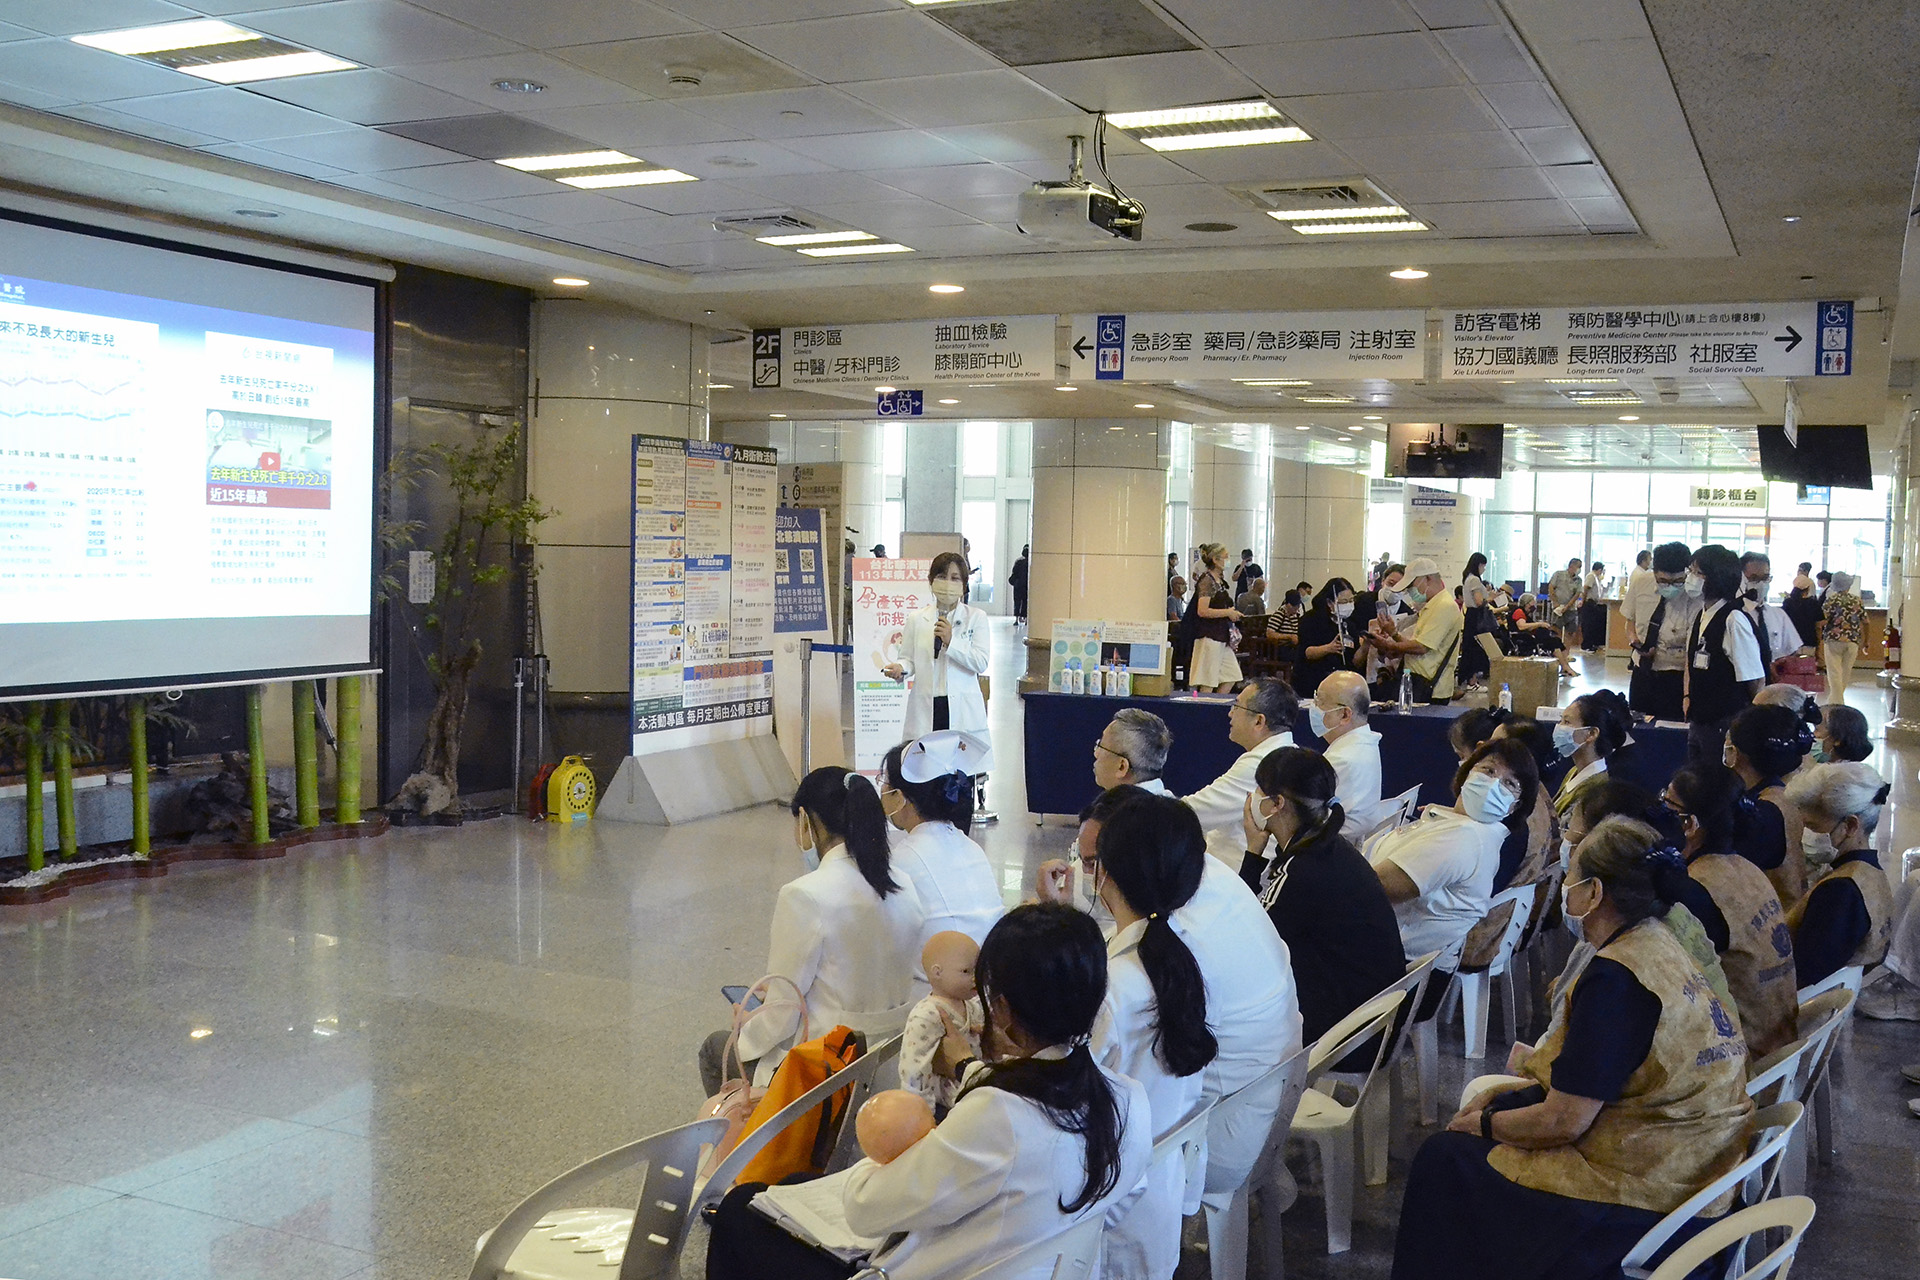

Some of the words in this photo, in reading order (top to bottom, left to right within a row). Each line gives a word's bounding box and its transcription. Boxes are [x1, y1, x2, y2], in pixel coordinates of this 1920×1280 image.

[1454, 312, 1541, 332] 訪客電梯
[794, 330, 842, 347] 門診區
[934, 322, 1007, 342] 抽血檢驗
[1132, 332, 1192, 351] 急診室
[1204, 330, 1341, 351] 藥局/急診藥局
[1350, 329, 1416, 350] 注射室
[756, 334, 780, 354] 2F
[1690, 343, 1758, 363] 社服室
[934, 351, 1023, 371] 膝關節中心
[1130, 355, 1168, 363] Emergency
[1203, 355, 1237, 363] Pharmacy
[1252, 354, 1288, 362] Pharmacy
[1348, 353, 1380, 361] Injection
[1454, 346, 1559, 366] 協力國議廳
[1567, 344, 1677, 364] 長照服務部
[794, 356, 900, 375] 中醫/牙科門診
[1626, 367, 1645, 375] Dept.
[1745, 366, 1765, 374] Dept.
[211, 467, 328, 486] 去年新生兒死亡率千分之2.8
[210, 487, 267, 504] 近15年最高
[1697, 488, 1757, 501] 轉診櫃台
[857, 586, 919, 609] 孕產安全
[876, 612, 908, 626] 你我
[638, 711, 684, 730] 本活動專區
[687, 700, 769, 724] 每月定期由公傳室更新
